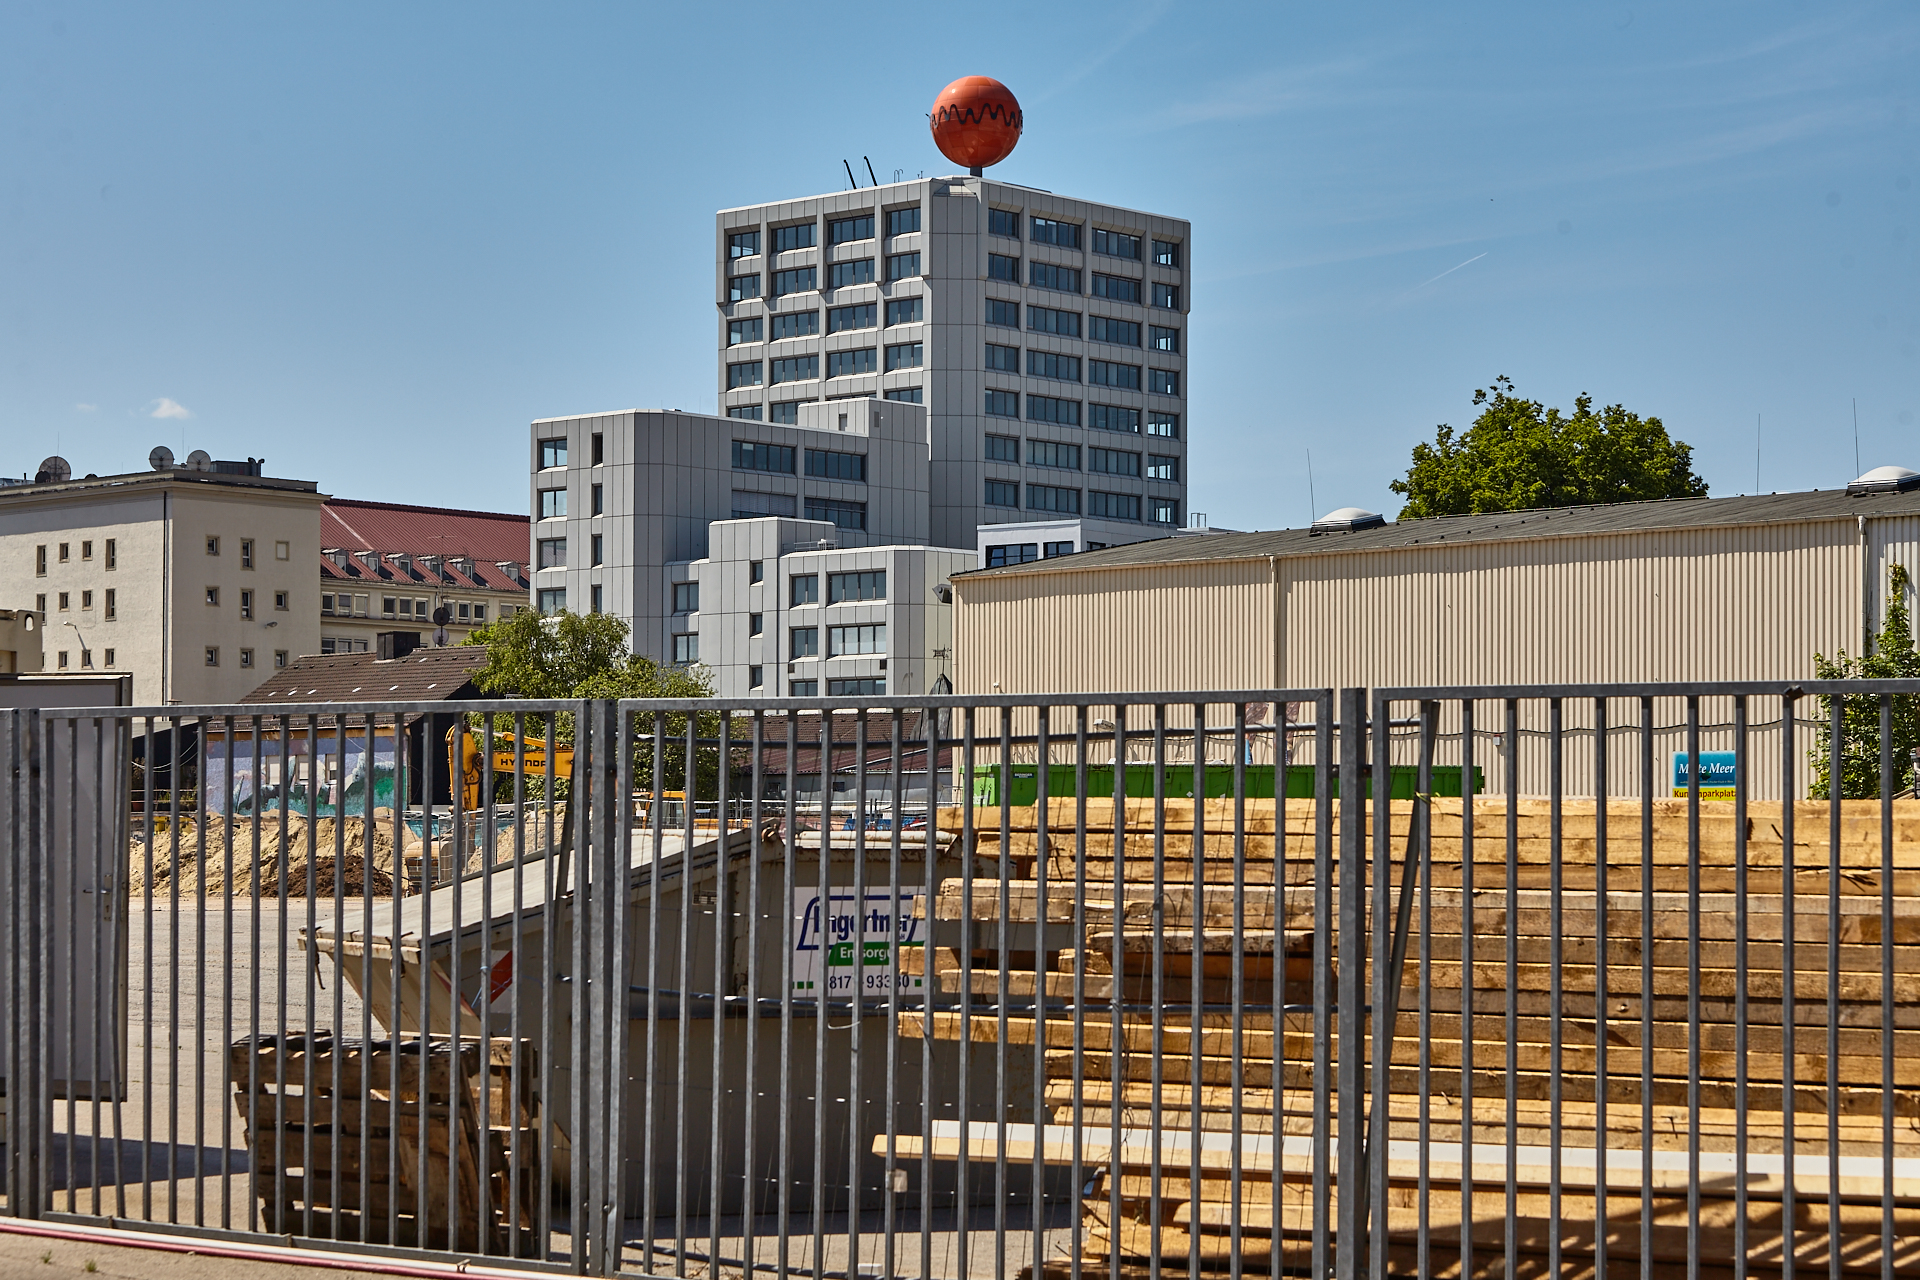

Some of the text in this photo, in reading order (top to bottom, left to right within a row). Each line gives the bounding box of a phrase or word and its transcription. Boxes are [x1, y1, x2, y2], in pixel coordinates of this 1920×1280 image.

[1678, 763, 1735, 774] Mte Meer
[1674, 789, 1738, 799] Kunnparkplat
